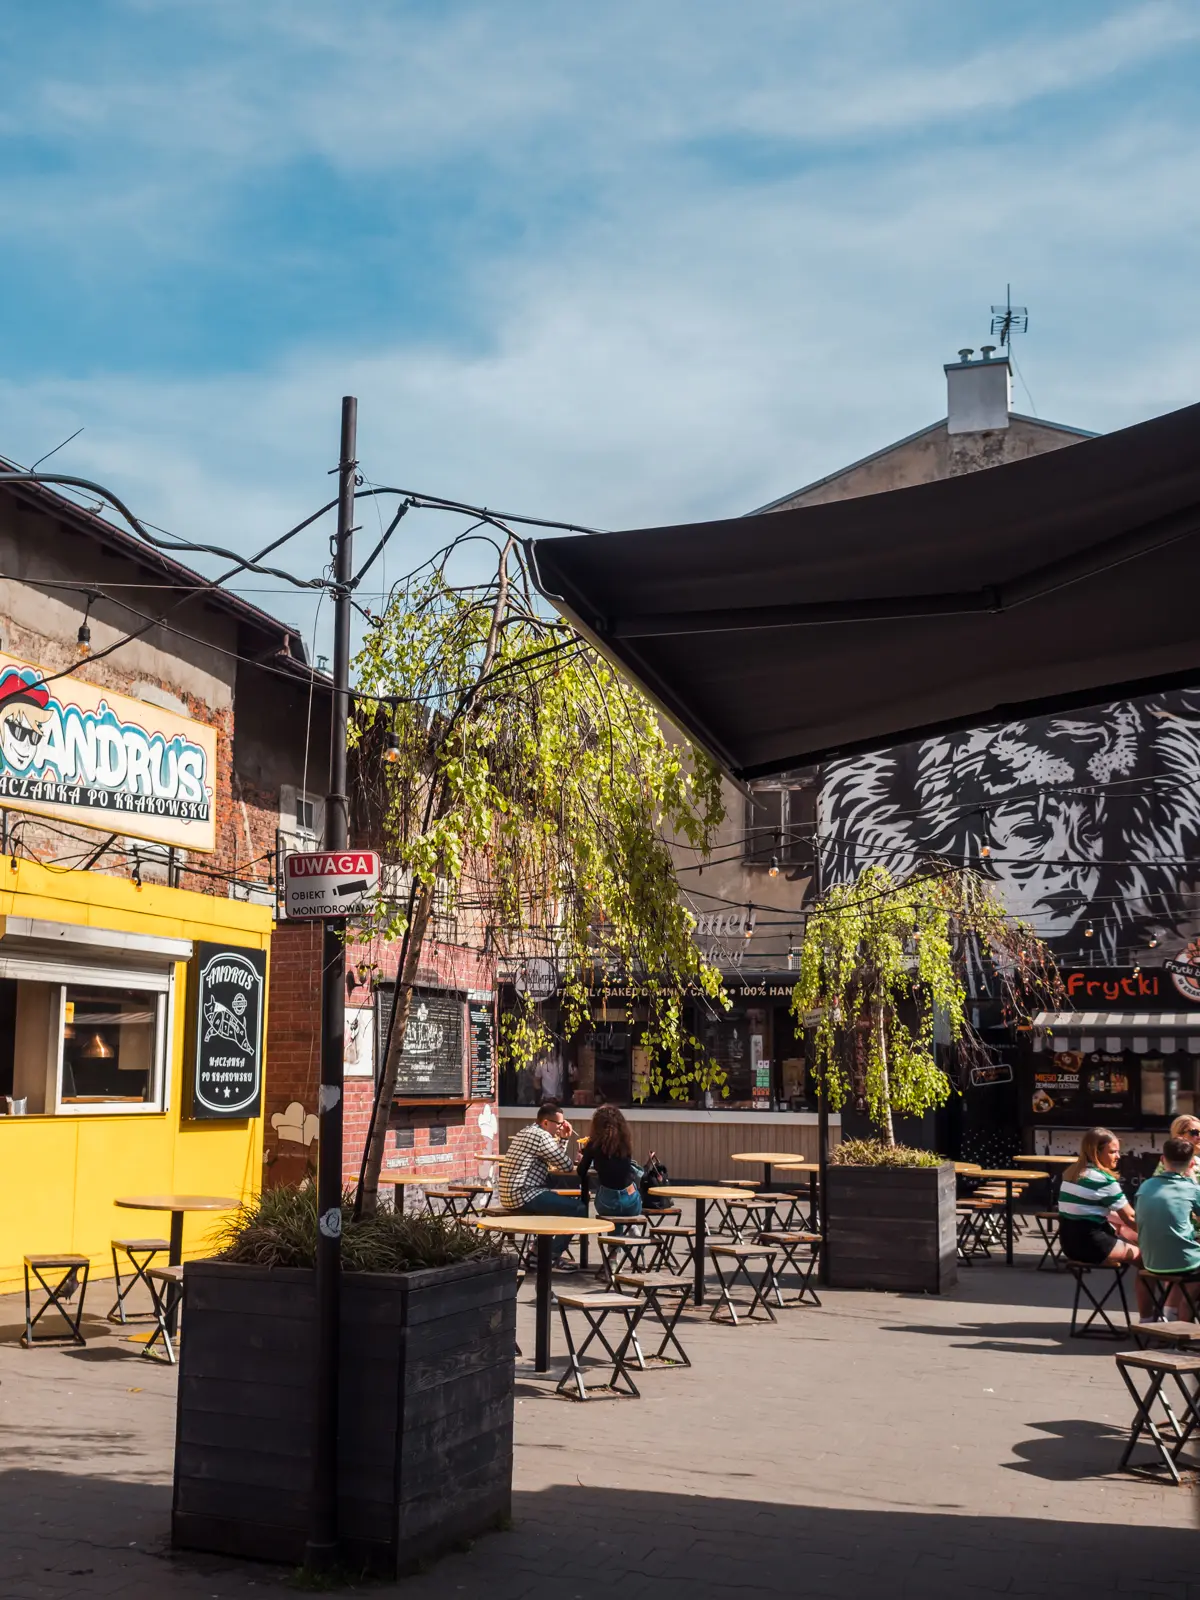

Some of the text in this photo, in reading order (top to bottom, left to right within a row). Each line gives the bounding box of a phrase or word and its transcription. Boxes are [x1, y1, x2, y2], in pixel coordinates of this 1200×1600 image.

[33, 709, 203, 800] ANDRUS
[87, 789, 109, 807] PO
[114, 793, 208, 820] KRAKOWSKU
[294, 856, 368, 875] UWAGA
[292, 890, 326, 900] OBIEKT
[292, 904, 374, 915] MONITOROWANY
[206, 965, 254, 990] ANDRUS
[1067, 973, 1159, 999] Frytki
[605, 987, 638, 997] BAKED
[740, 986, 766, 996] 100%
[769, 986, 793, 996] HAN
[201, 1071, 211, 1082] PO
